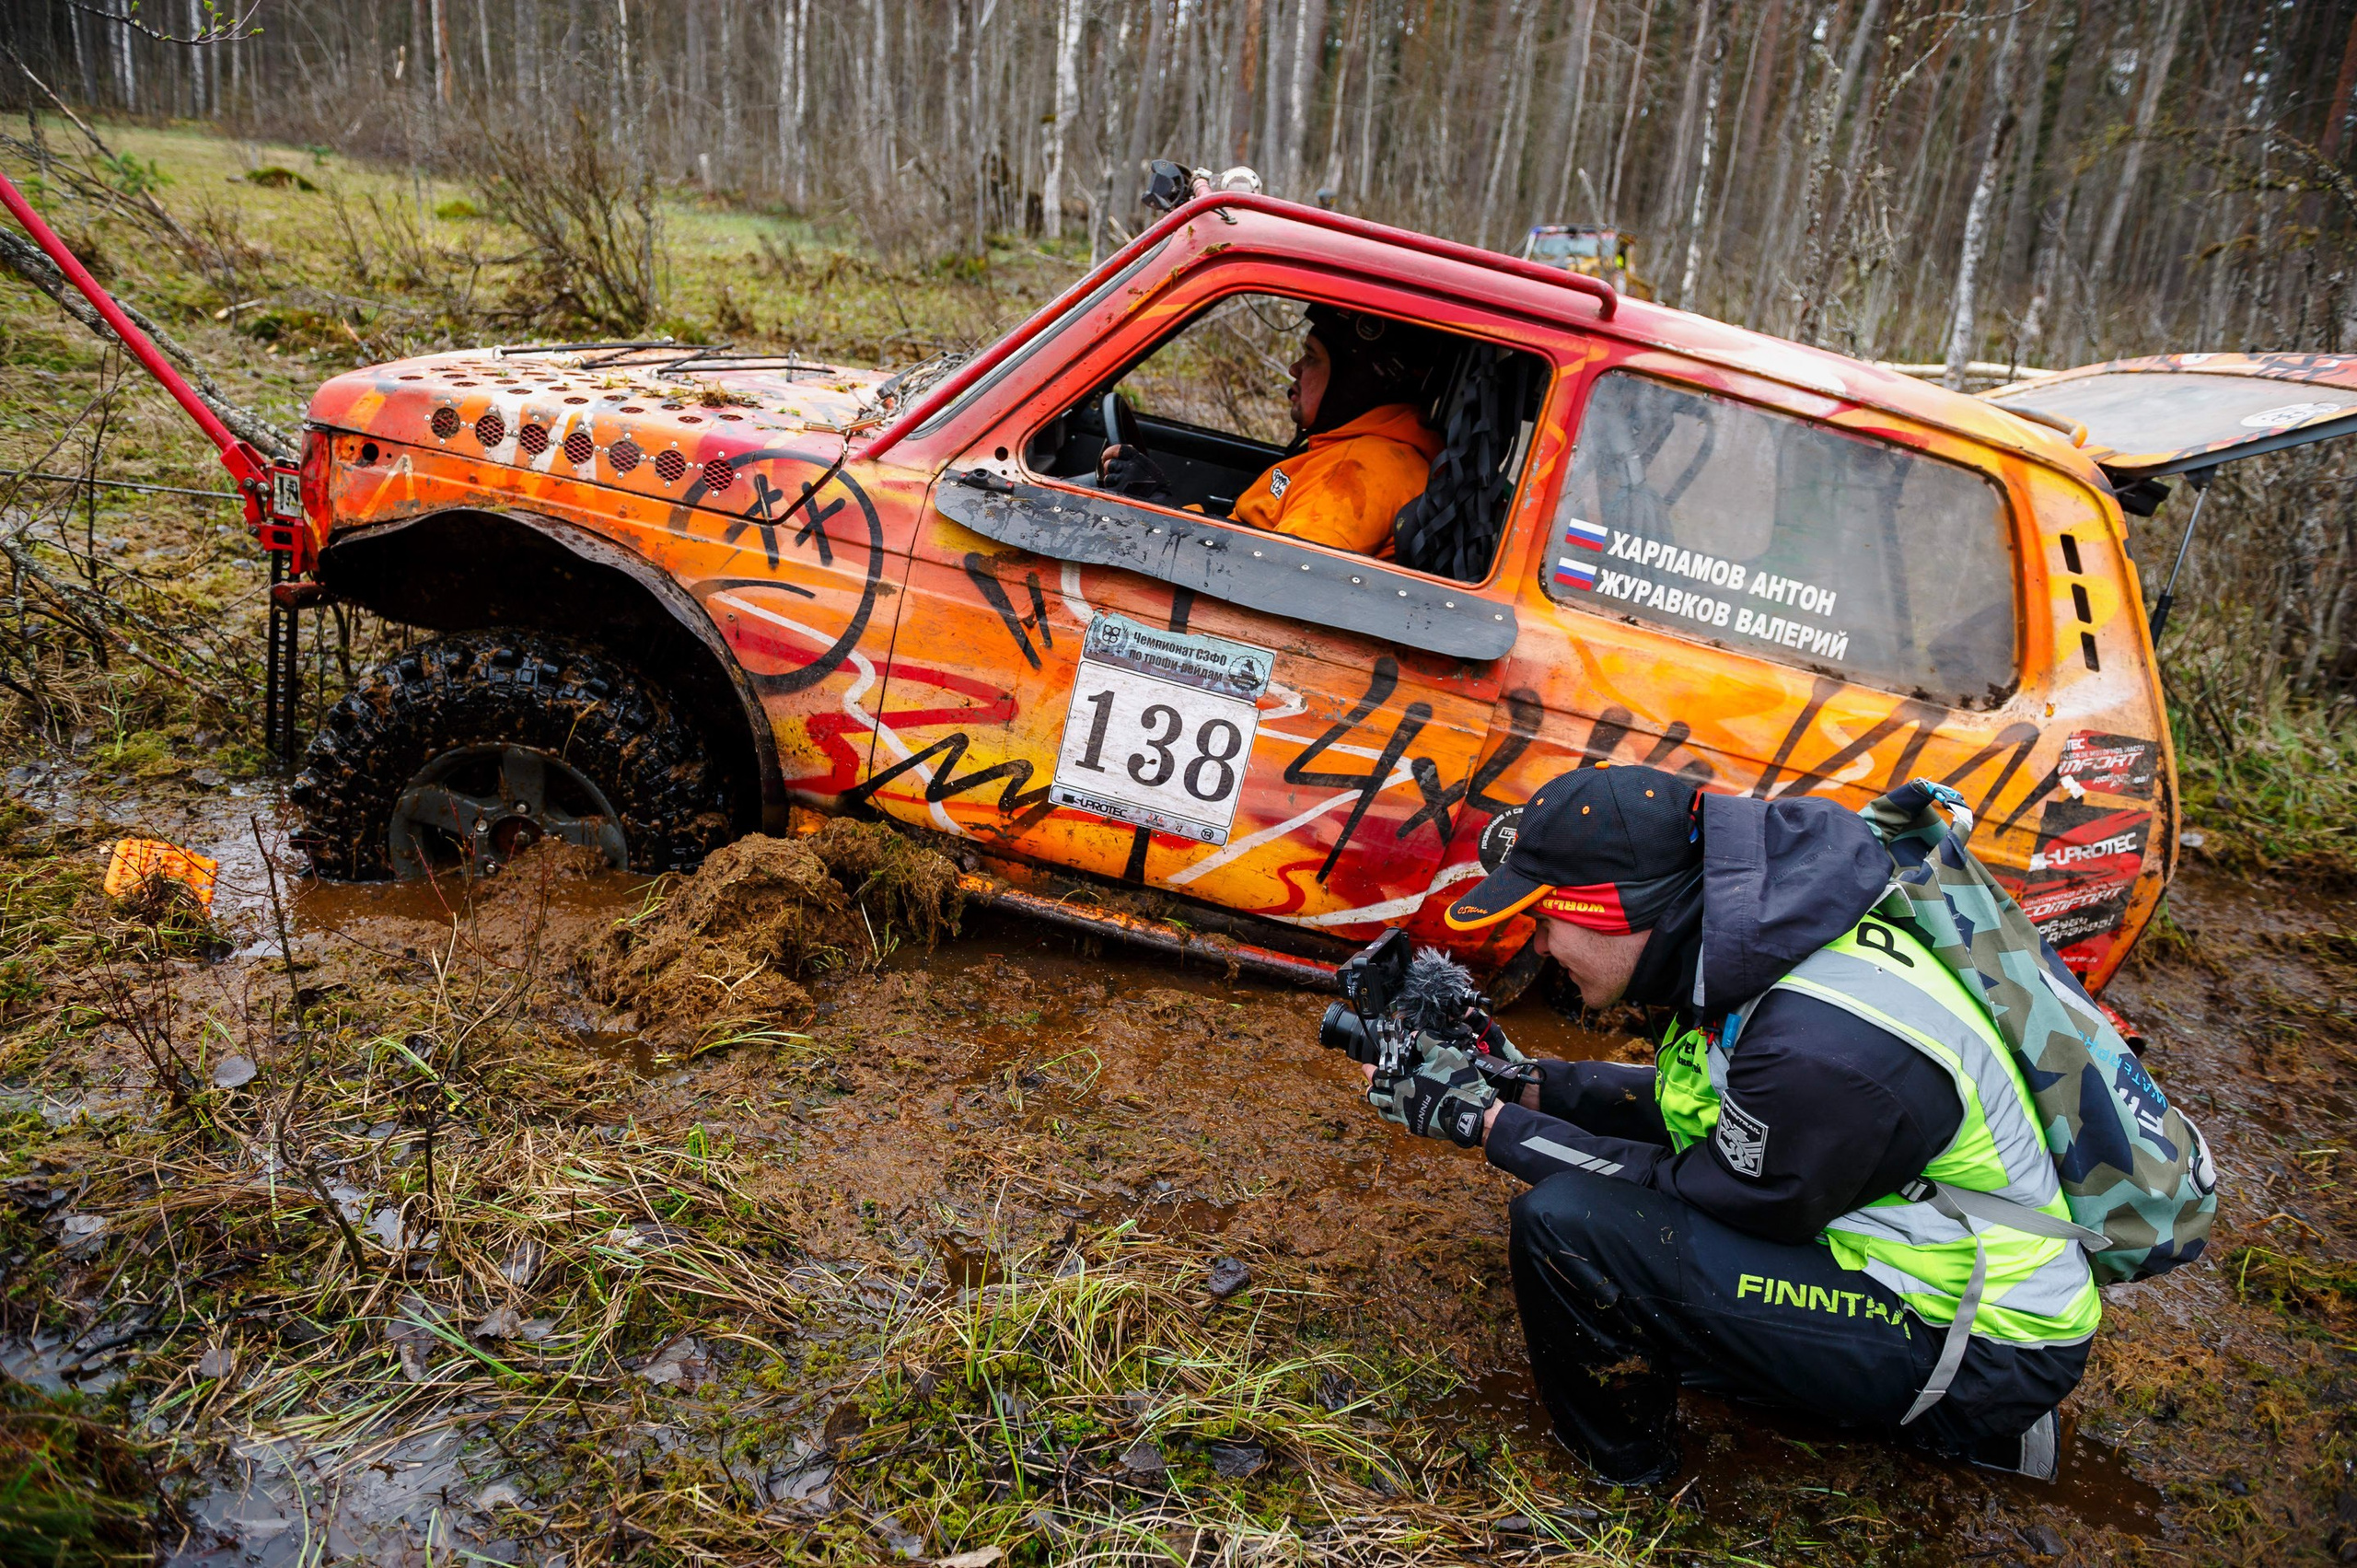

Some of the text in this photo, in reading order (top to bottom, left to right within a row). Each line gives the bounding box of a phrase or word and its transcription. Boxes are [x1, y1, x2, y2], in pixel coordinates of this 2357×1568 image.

[1607, 530, 1837, 617] ХАРЛАМОВ АНТОН
[1596, 568, 1850, 661] ЖУРАВКОВ ВАЛЕРИЙ
[1129, 649, 1143, 661] по
[1144, 653, 1224, 681] трофи-рейдам
[1133, 632, 1227, 666] Чемпионат СЗФО
[1074, 690, 1242, 802] 138
[1072, 796, 1129, 819] SUPROTEC
[2046, 831, 2138, 866] SUPROTEC
[1542, 899, 1606, 913] WORLD
[2022, 885, 2126, 918] COMFORT
